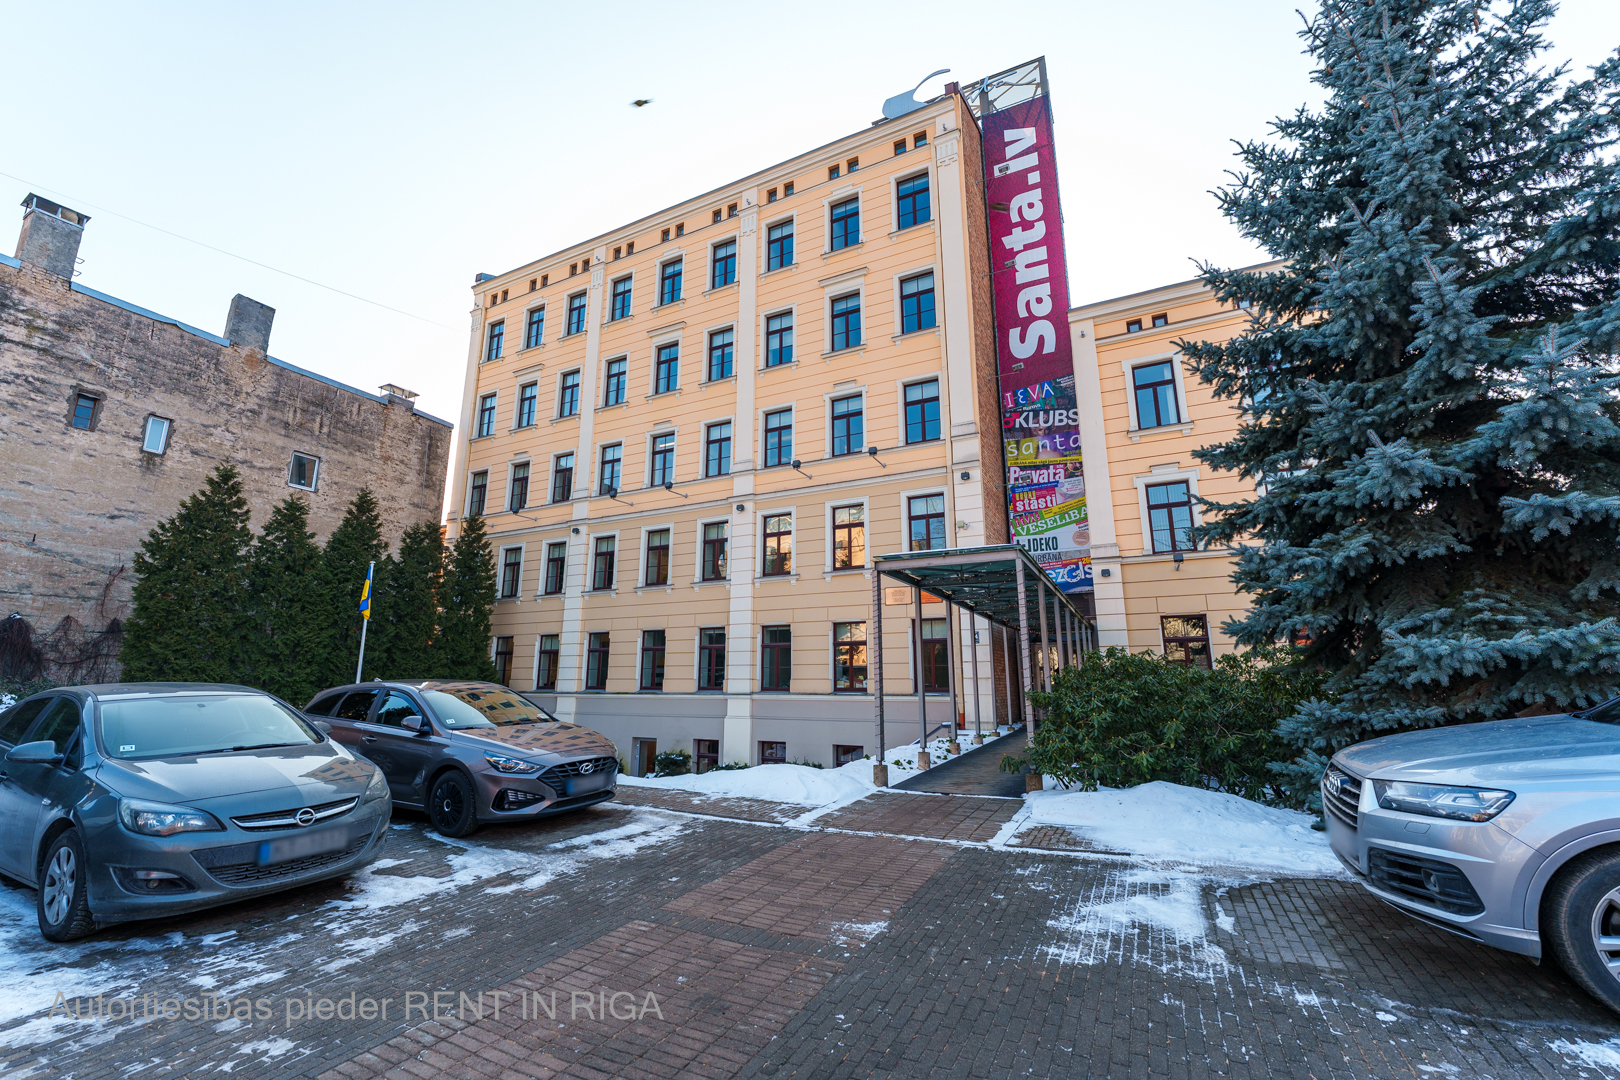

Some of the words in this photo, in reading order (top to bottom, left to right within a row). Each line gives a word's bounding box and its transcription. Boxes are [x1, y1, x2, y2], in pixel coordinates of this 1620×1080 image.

[993, 126, 1056, 360] Santa.lv
[1005, 382, 1055, 408] IEVA
[1015, 408, 1079, 428] KLUBS
[1007, 434, 1081, 457] santa
